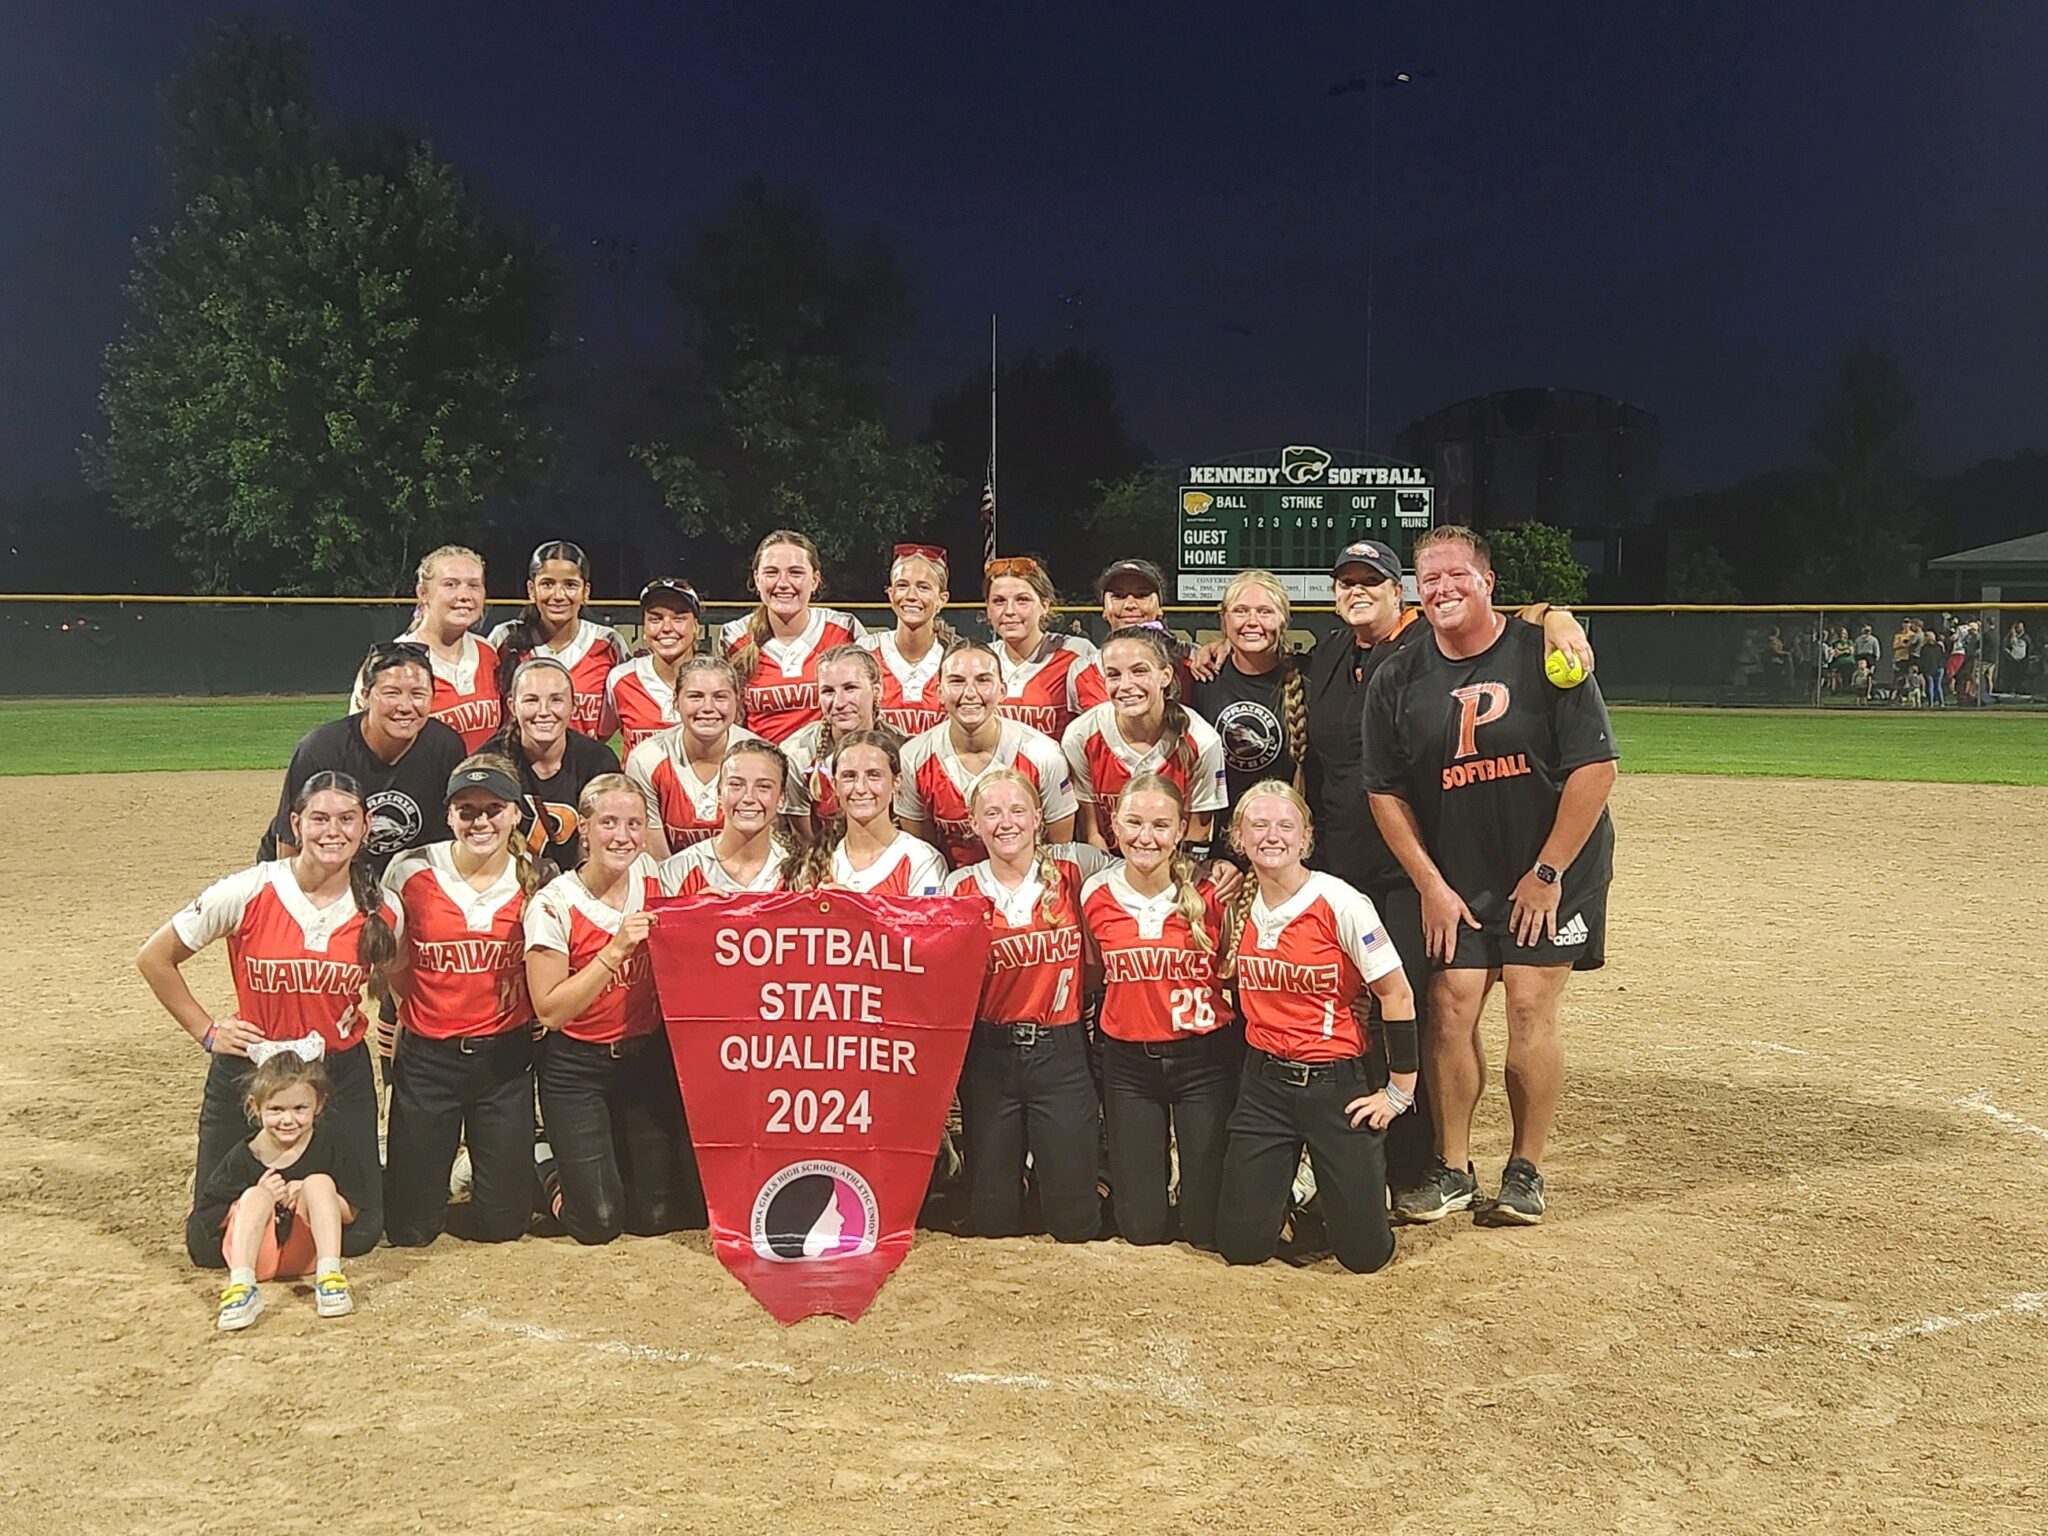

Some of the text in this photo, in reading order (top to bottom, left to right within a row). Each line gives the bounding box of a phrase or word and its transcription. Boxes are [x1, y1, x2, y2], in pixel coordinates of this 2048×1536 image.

[1189, 466, 1426, 485] KENNEDY SOFTBALL
[1216, 496, 1377, 509] BALL STRIKE OUT
[1183, 529, 1228, 545] GUEST
[1243, 517, 1428, 528] 1 2 3 4 5 6 7 8 9 RUNS
[1184, 550, 1227, 565] HOME
[1222, 704, 1275, 729] PRAIRIE
[1449, 681, 1511, 760] P
[1222, 742, 1278, 768] OFTBALL
[1442, 753, 1532, 790] SOFTBALL
[366, 794, 416, 816] RAIRIE
[412, 938, 524, 974] HAWK
[714, 927, 925, 974] SOFTBALL
[990, 925, 1081, 975] AWKS
[1553, 932, 1588, 946] adida
[245, 956, 366, 996] HAWK
[1237, 955, 1339, 994] AWKS
[759, 982, 883, 1024] STATE
[1170, 986, 1216, 1032] 26
[1322, 999, 1335, 1041] 1
[719, 1035, 918, 1075] QUALIFIER
[765, 1089, 872, 1134] 2024
[754, 1163, 876, 1236] IOWA GIRLS HIGH SCHOOL ATHLETIC UNION
